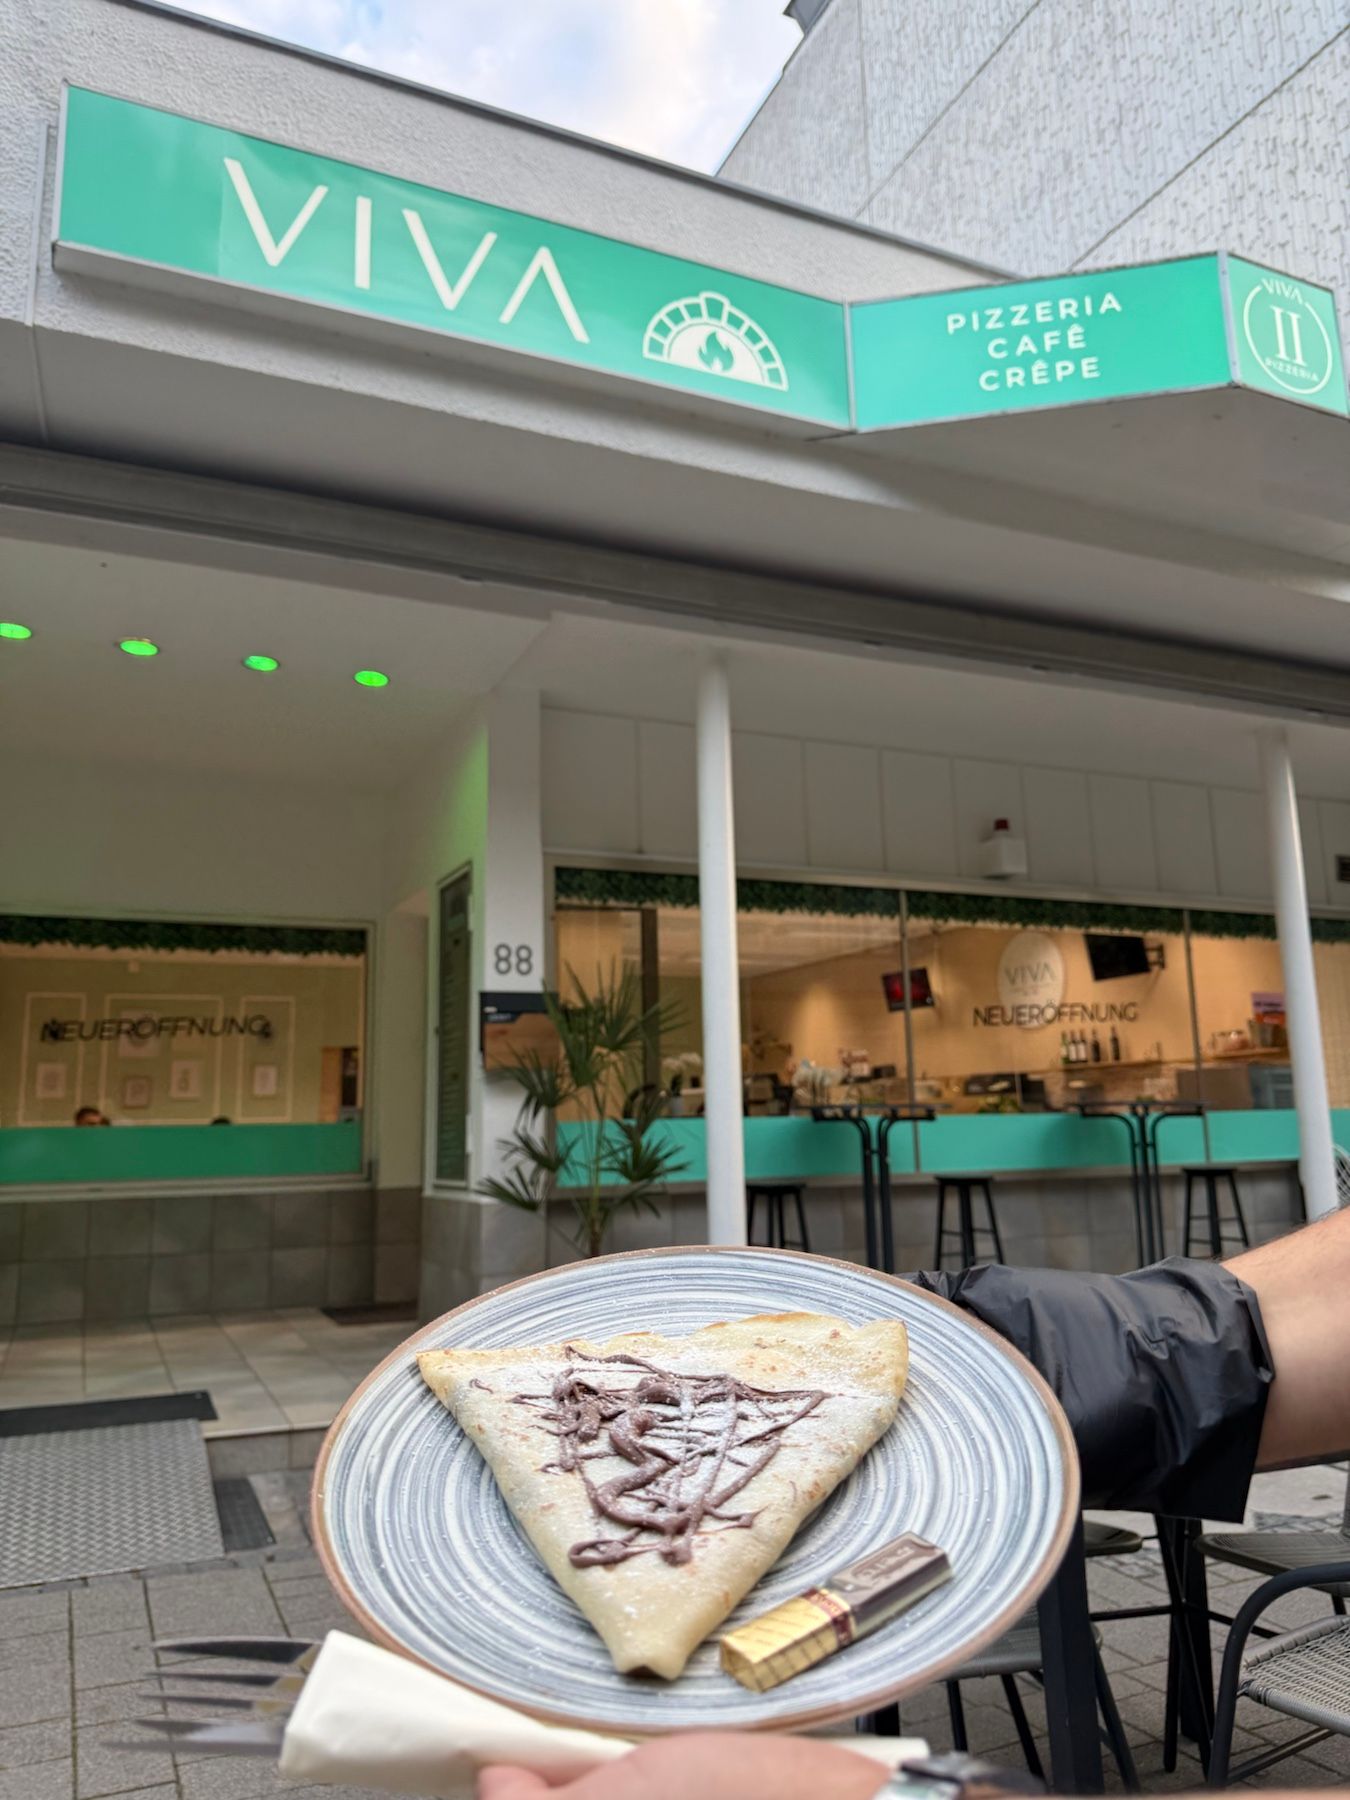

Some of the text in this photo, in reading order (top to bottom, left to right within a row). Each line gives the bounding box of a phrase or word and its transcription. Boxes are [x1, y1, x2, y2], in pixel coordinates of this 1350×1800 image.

[223, 157, 590, 344] VIVA
[1261, 278, 1304, 304] VIVA
[946, 292, 1122, 335] PIZZERIA
[979, 358, 1100, 391] CRÊPE
[495, 943, 532, 975] 88
[1004, 961, 1056, 986] VIVA
[972, 999, 1138, 1026] NEUERÖFFNUNG
